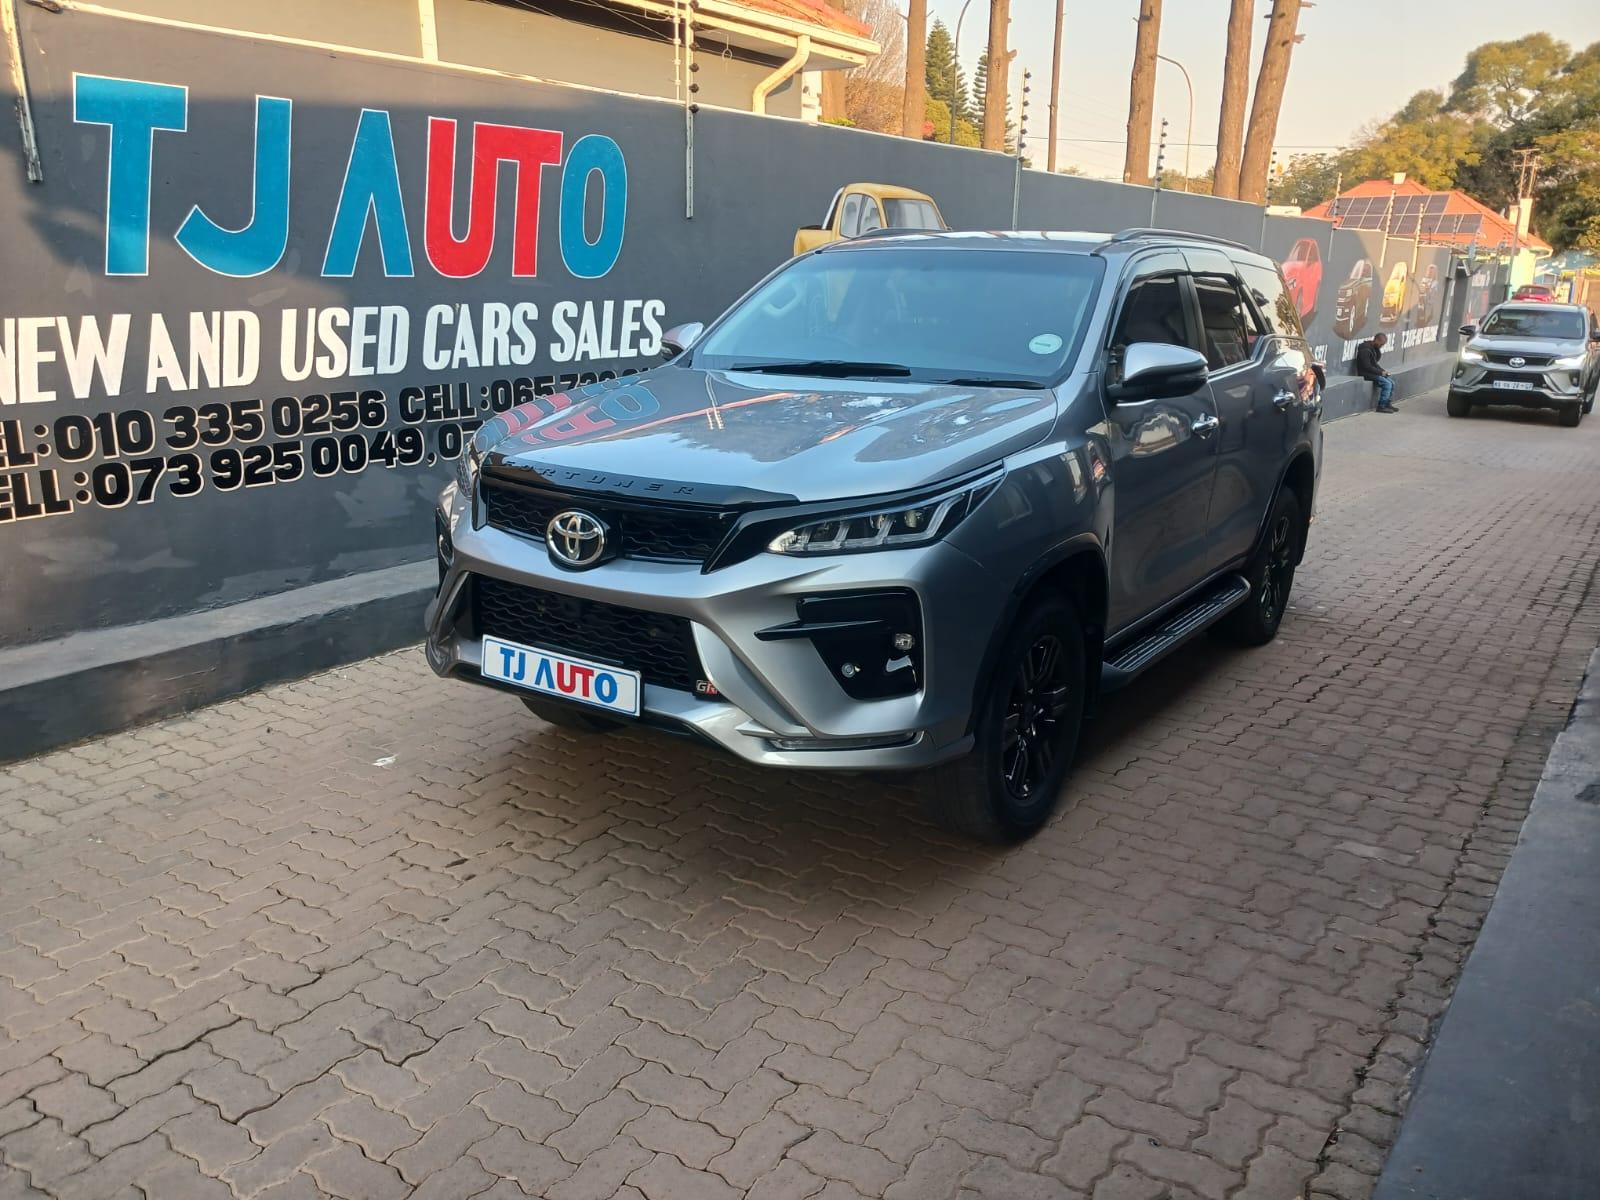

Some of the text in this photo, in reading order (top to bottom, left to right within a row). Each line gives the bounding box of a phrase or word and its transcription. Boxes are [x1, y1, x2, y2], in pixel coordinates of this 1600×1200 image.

[72, 72, 628, 279] TJ AUTO
[145, 309, 260, 394] AND
[280, 304, 410, 382] USED
[422, 301, 538, 371] CARS
[549, 299, 666, 363] SALES
[163, 399, 265, 450] 335
[271, 389, 388, 438] 0256
[210, 440, 304, 493] 925
[499, 646, 618, 704] TJ AUTO
